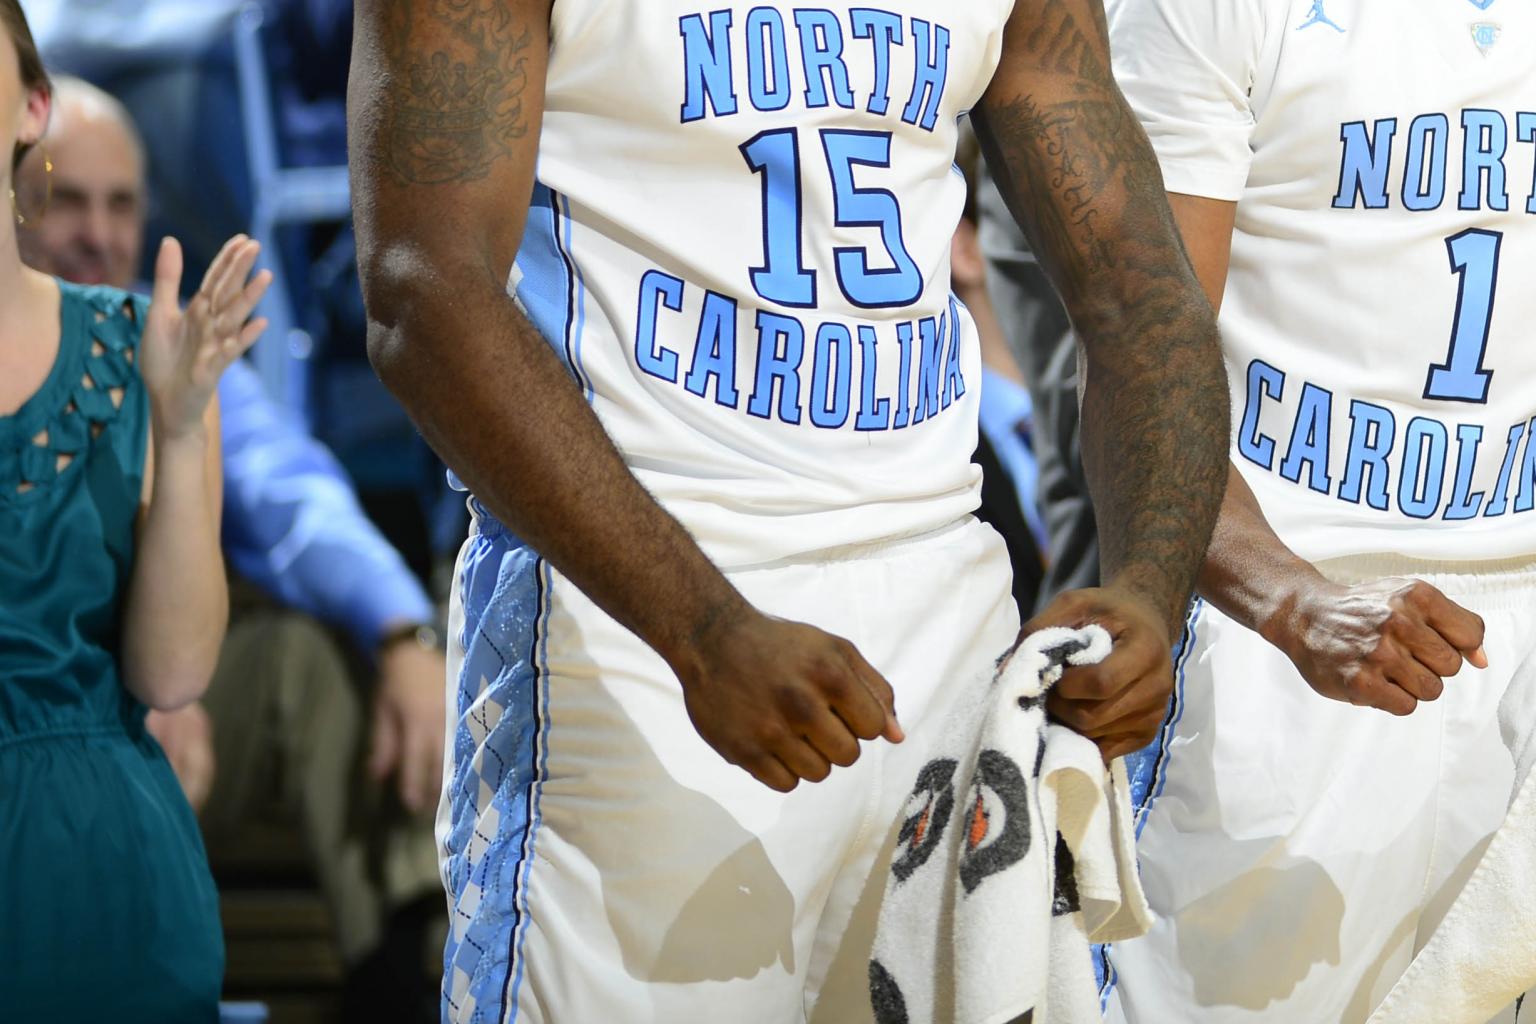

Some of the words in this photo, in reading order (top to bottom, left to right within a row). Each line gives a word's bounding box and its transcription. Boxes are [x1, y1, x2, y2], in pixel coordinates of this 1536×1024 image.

[679, 6, 951, 131] NORTH
[737, 127, 924, 309] 15
[634, 269, 966, 432] CAROLINA
[1422, 227, 1504, 404] 1
